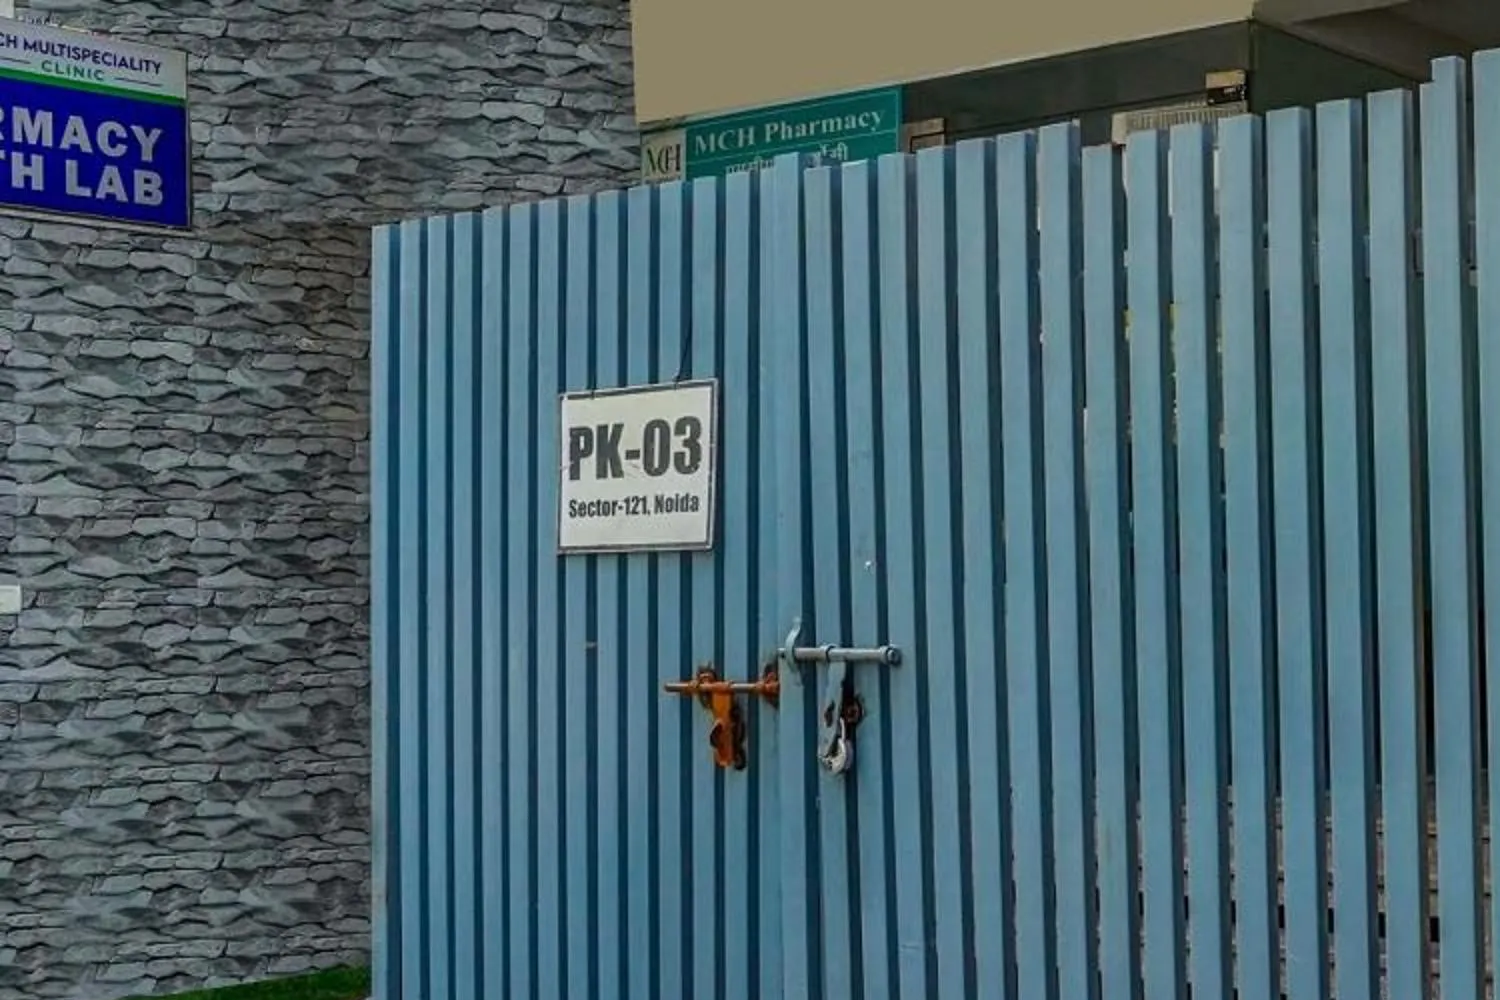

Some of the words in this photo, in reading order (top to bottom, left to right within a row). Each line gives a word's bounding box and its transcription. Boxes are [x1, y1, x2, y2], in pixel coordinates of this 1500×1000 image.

[23, 37, 162, 76] MULTISPECIALITY
[41, 60, 105, 82] CLINIC
[0, 104, 163, 164] MACY
[694, 126, 756, 155] MCH
[764, 109, 886, 143] Pharmacy
[65, 159, 163, 207] LAB
[568, 415, 702, 481] PK-03
[654, 491, 700, 516] Noida
